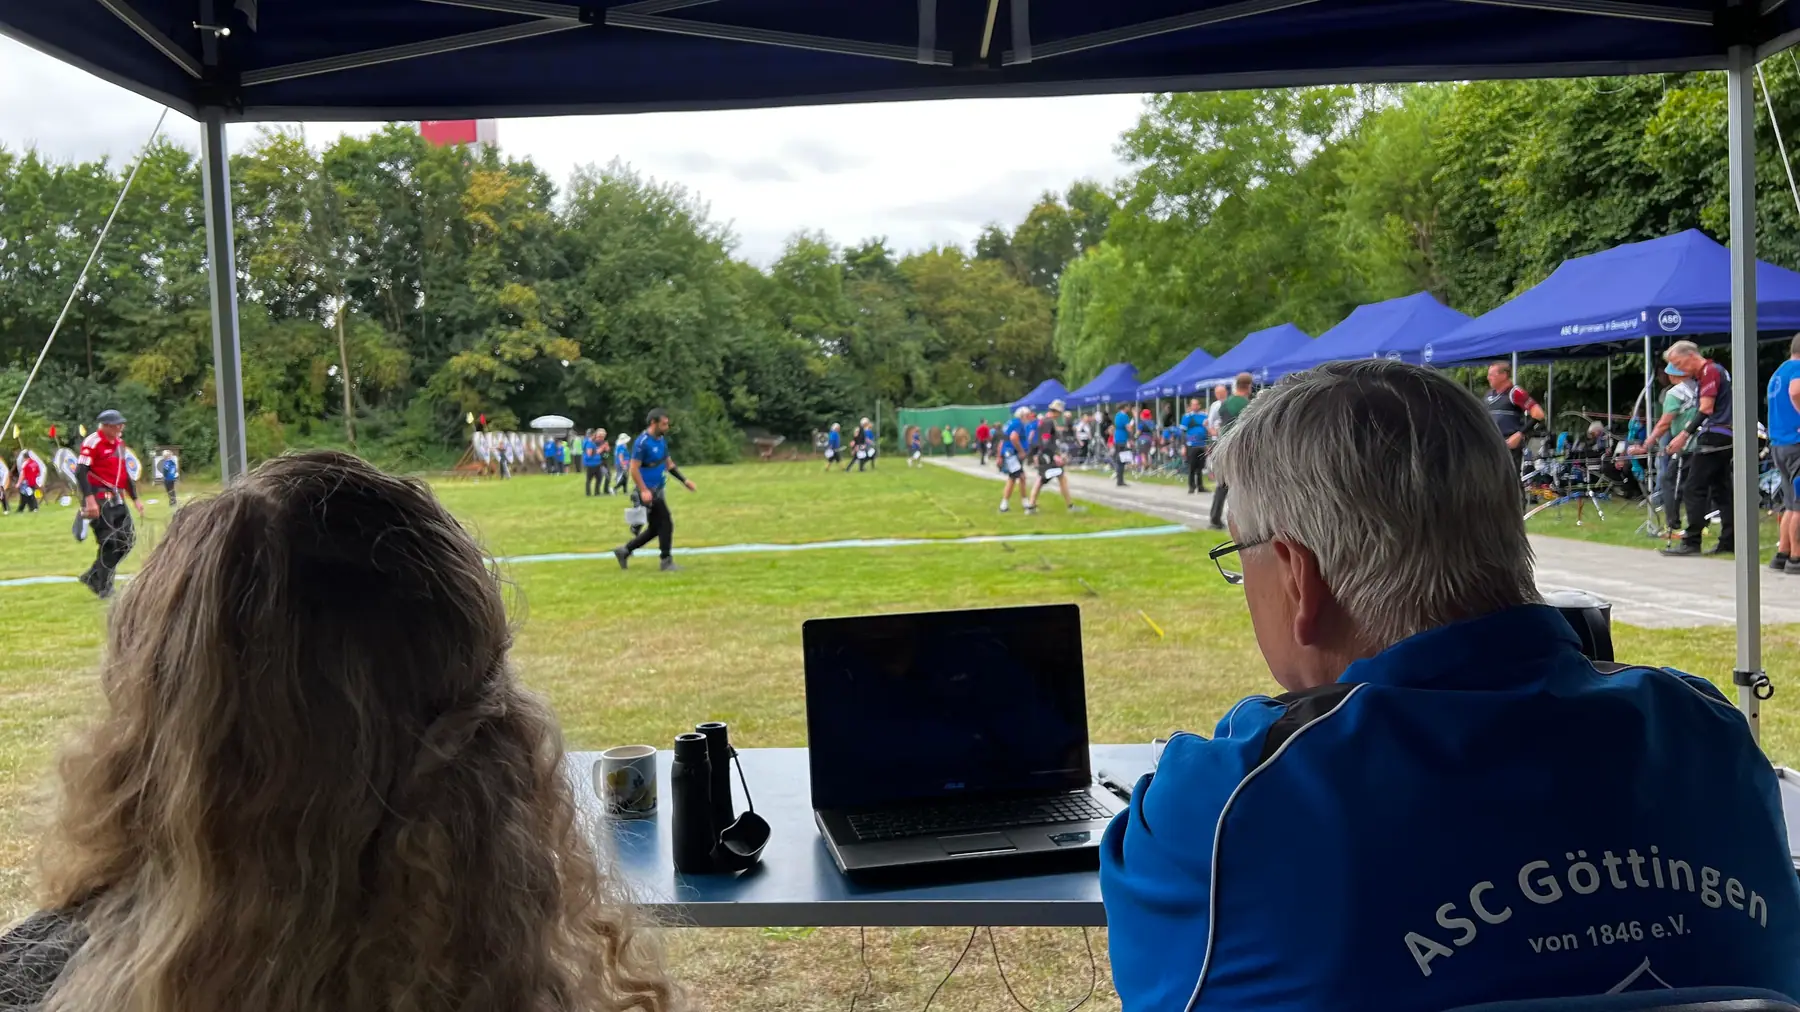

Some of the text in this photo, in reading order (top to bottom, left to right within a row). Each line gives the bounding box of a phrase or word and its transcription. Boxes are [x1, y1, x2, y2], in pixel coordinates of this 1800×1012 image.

[1662, 314, 1679, 324] ASC
[1404, 845, 1768, 977] ASC Göttingen
[1528, 913, 1692, 953] von 1846 e.V.
